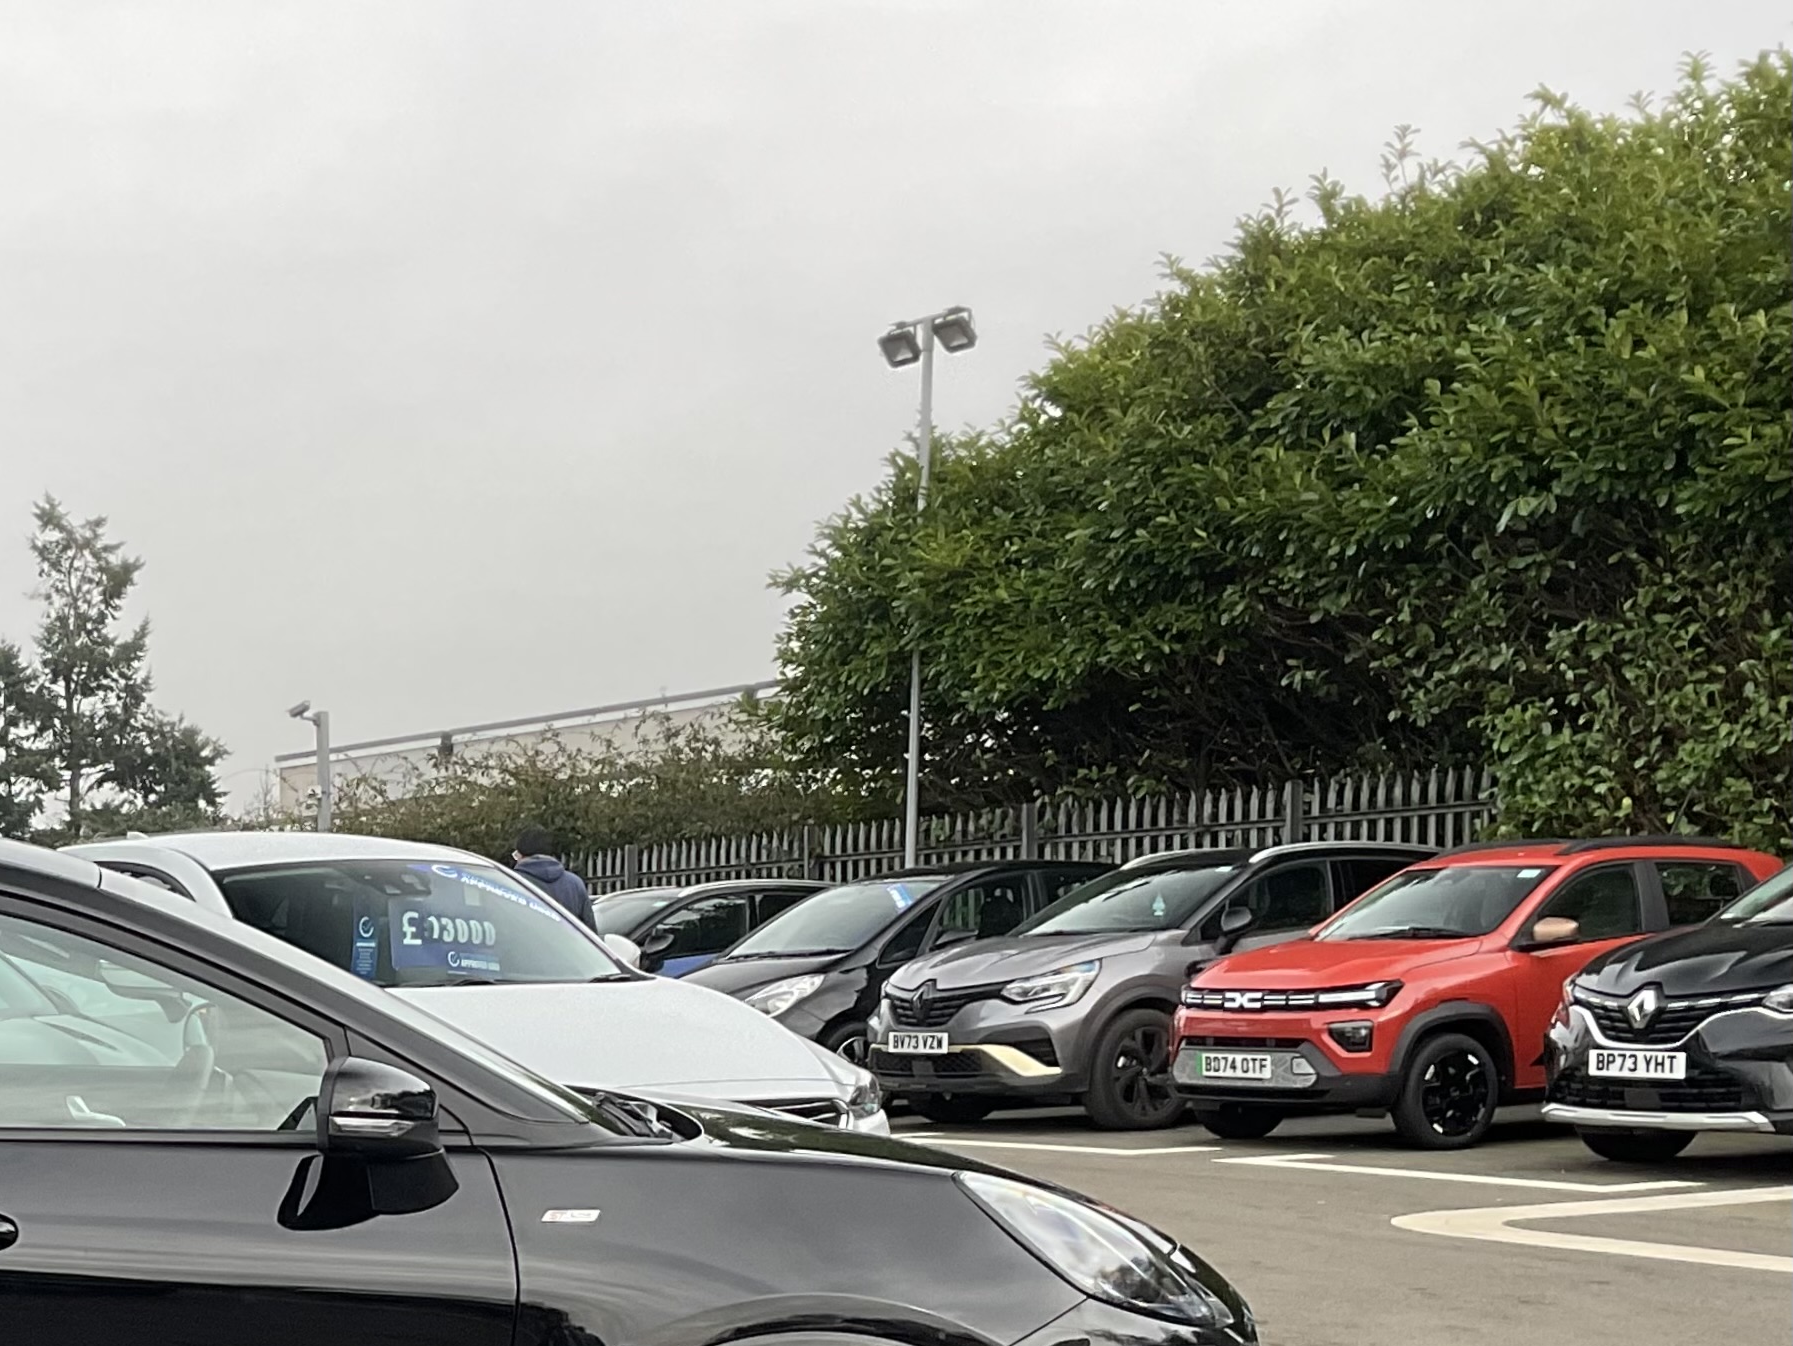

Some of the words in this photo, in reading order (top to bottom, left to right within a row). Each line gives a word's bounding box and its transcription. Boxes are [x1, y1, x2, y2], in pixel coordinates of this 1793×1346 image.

[893, 1034, 919, 1050] BV73
[1240, 1057, 1268, 1075] OTF
[1596, 1052, 1638, 1073] BP73
[1643, 1054, 1677, 1074] YHT
